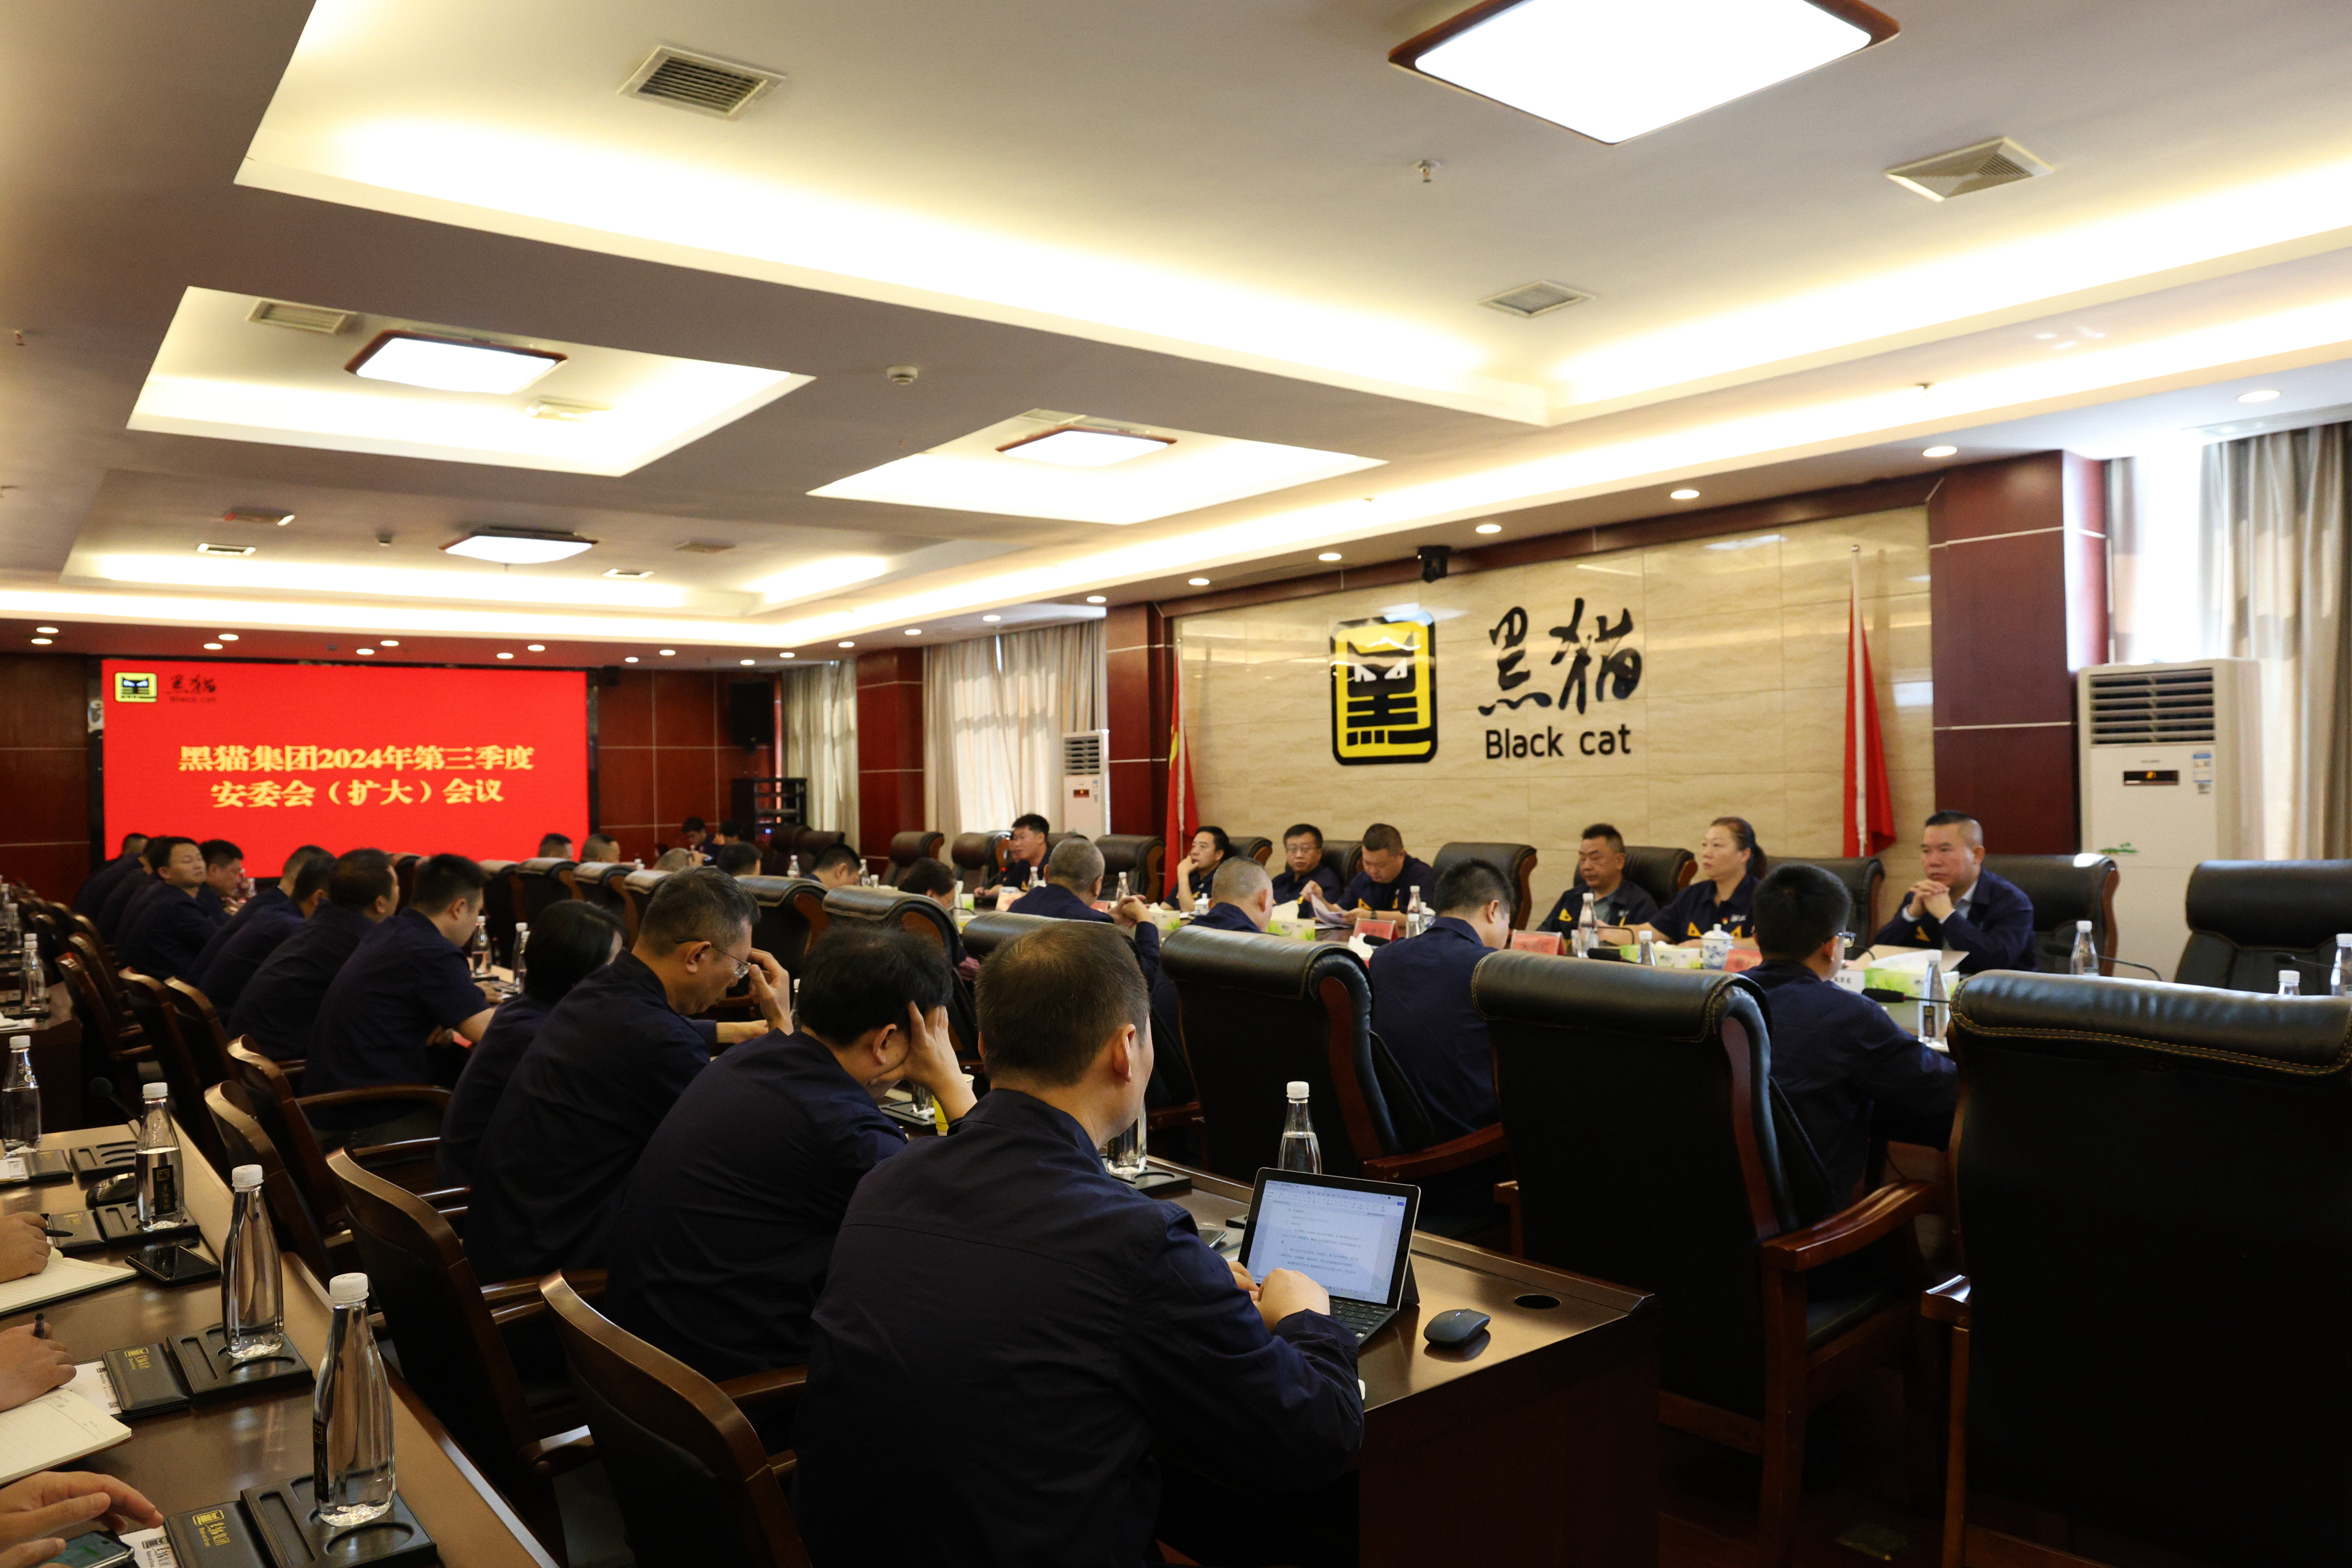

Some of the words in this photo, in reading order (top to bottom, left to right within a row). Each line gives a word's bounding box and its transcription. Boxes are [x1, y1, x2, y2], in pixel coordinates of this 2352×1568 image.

[1478, 598, 1642, 716] 黑猫
[1486, 725, 1564, 759] Black
[1579, 724, 1631, 755] cat
[178, 745, 534, 771] 黑猫集团2024年第三季度
[211, 778, 504, 808] 安委会（扩大）会议
